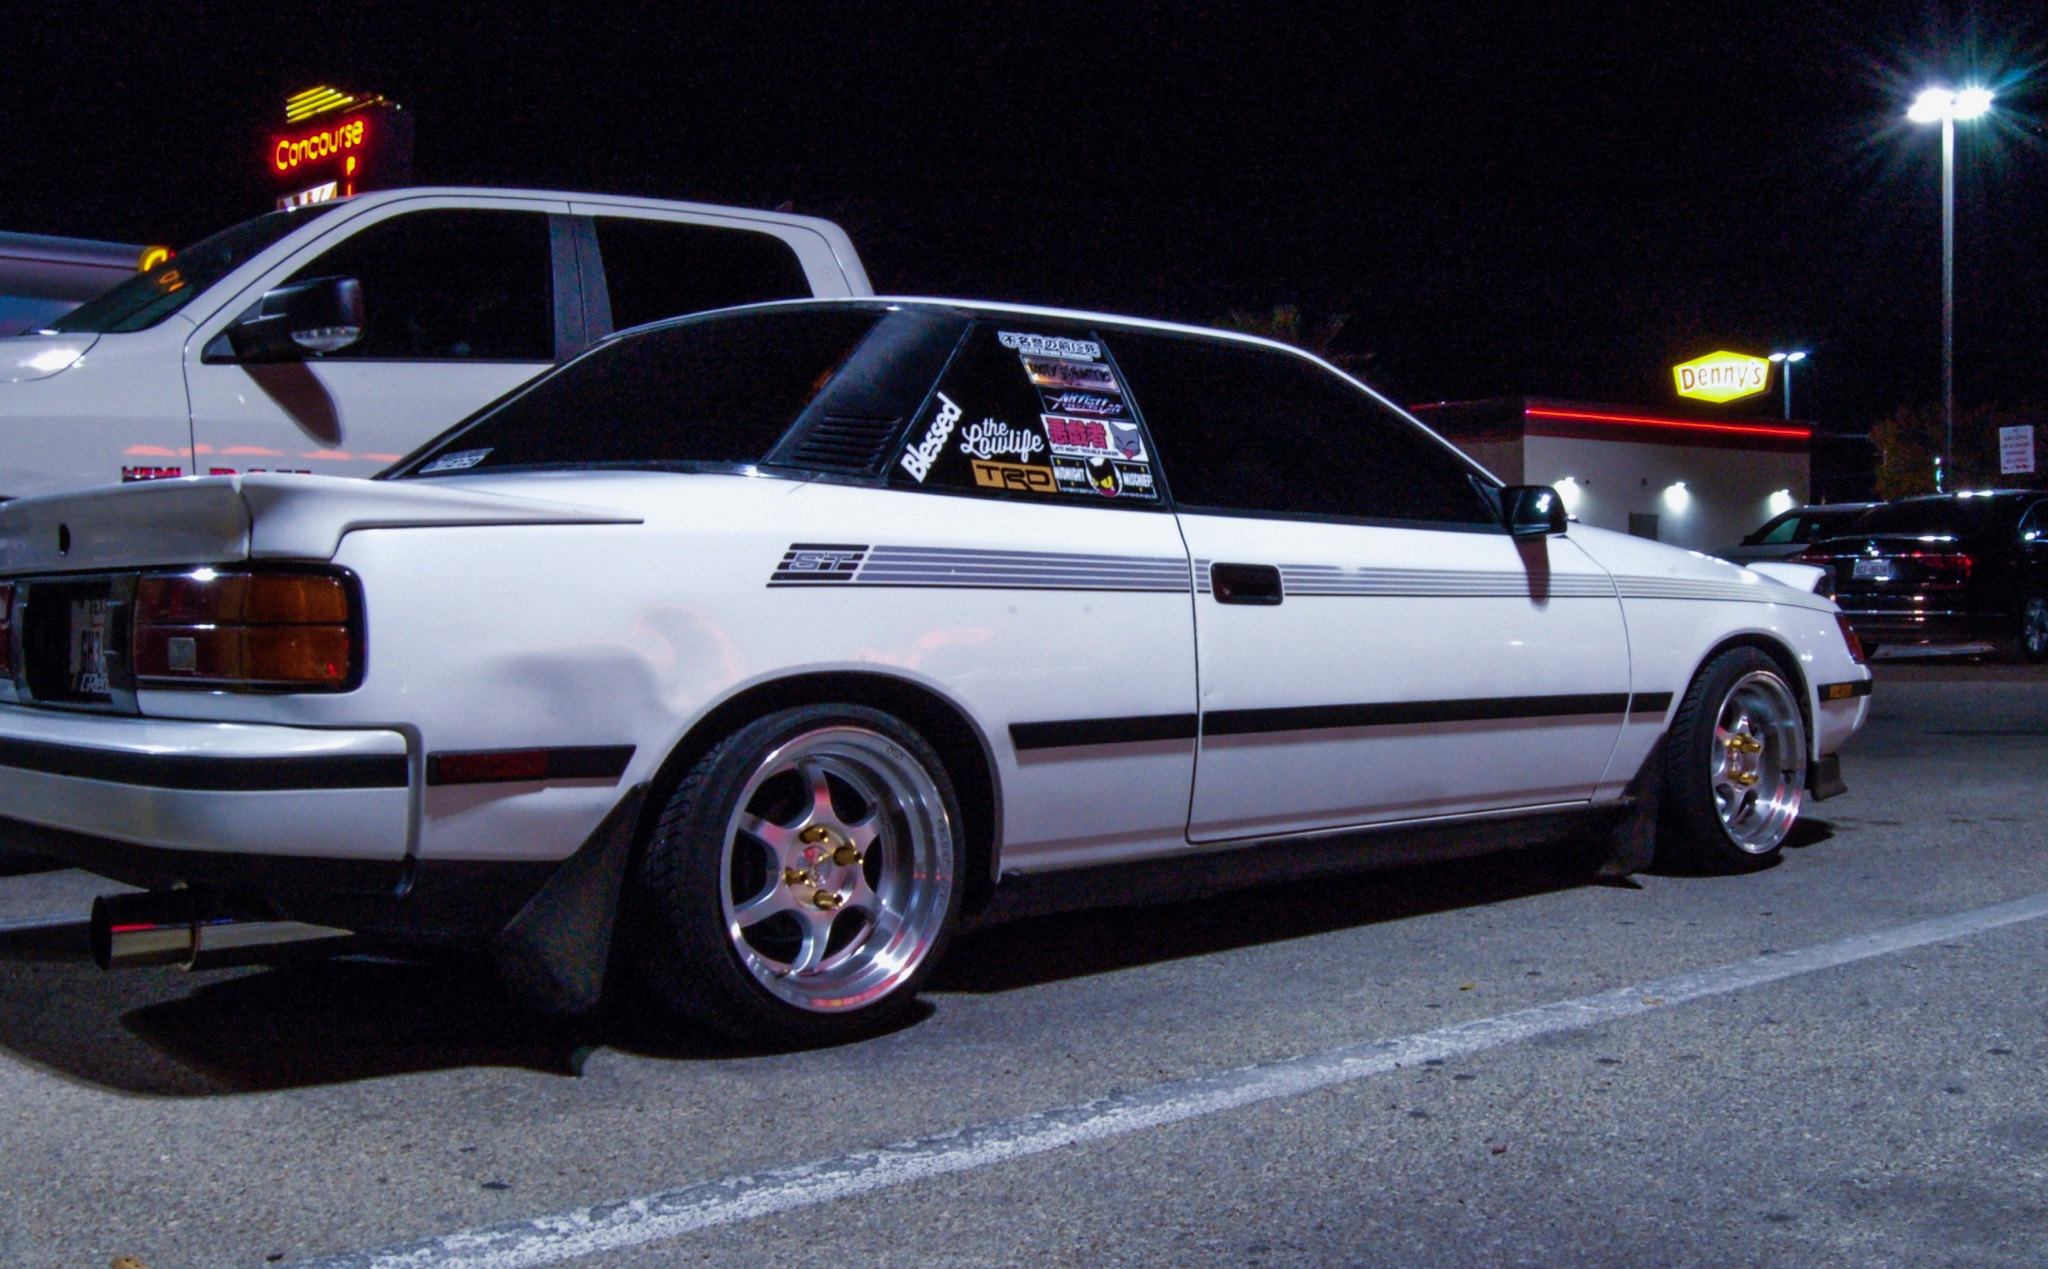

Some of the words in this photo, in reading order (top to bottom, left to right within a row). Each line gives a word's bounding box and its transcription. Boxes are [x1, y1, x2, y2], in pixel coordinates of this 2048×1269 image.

[276, 120, 364, 170] Concourse
[1681, 361, 1762, 391] Denny's
[900, 391, 962, 483] Blessed
[983, 418, 1009, 437] the
[960, 424, 1045, 463] Lowlife
[976, 464, 1050, 491] TRD
[1053, 466, 1085, 482] MIDNIGHT
